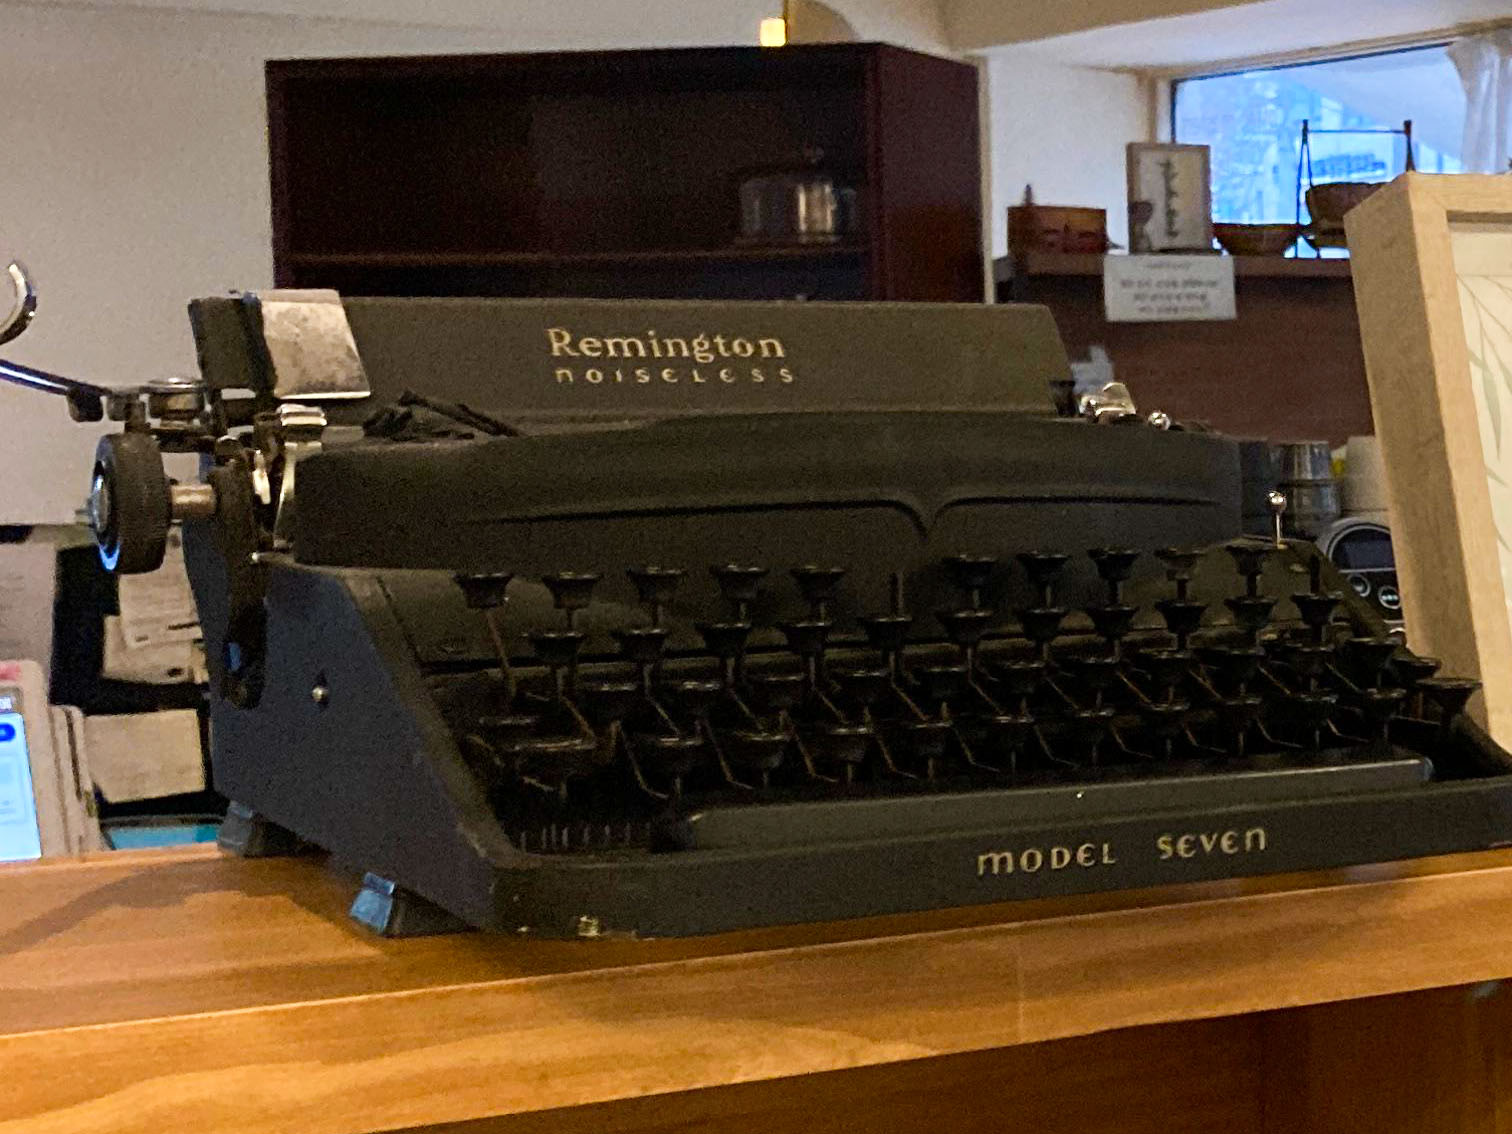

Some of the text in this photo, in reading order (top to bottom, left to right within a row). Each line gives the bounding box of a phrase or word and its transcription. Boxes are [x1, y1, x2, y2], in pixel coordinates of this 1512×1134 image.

[547, 327, 786, 364] Remington
[977, 827, 1267, 877] MODEL SEVEN
